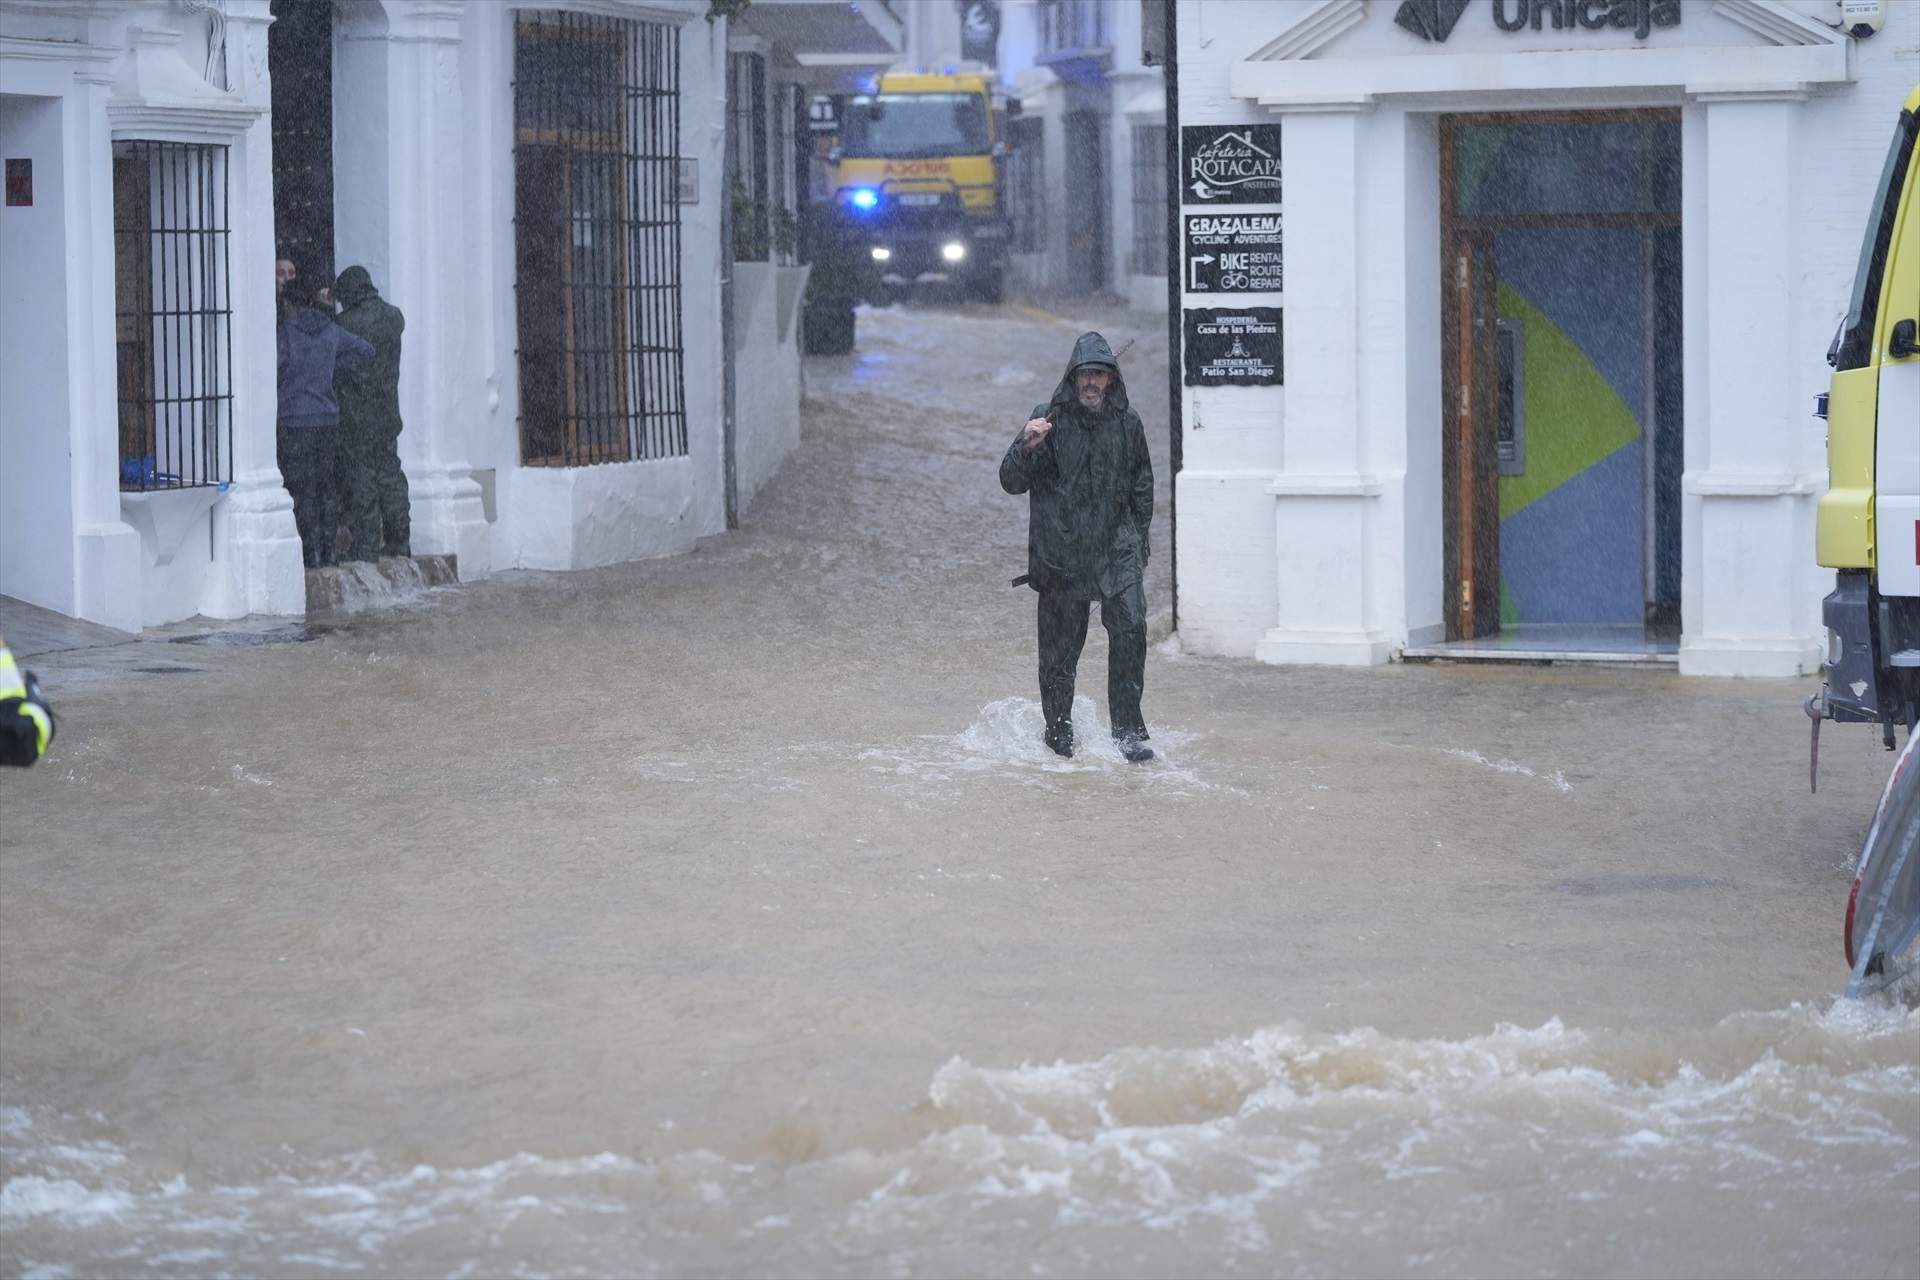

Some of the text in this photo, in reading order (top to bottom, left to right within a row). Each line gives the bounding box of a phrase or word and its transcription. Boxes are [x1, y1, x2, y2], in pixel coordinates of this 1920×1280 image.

[1492, 0, 1681, 40] Unicaja
[1190, 157, 1282, 178] ROTACAPA
[1189, 217, 1282, 234] GRAZALEMA
[1192, 234, 1282, 244] CYCLING ADVENTURES
[1220, 252, 1249, 270] BIKE
[1250, 253, 1282, 263] RENTAL
[1250, 278, 1281, 289] REPAIR
[1197, 325, 1277, 334] Casa de las Piedras
[1212, 358, 1262, 366] RESTAURANTE
[1202, 367, 1275, 378] Patio San Diego
